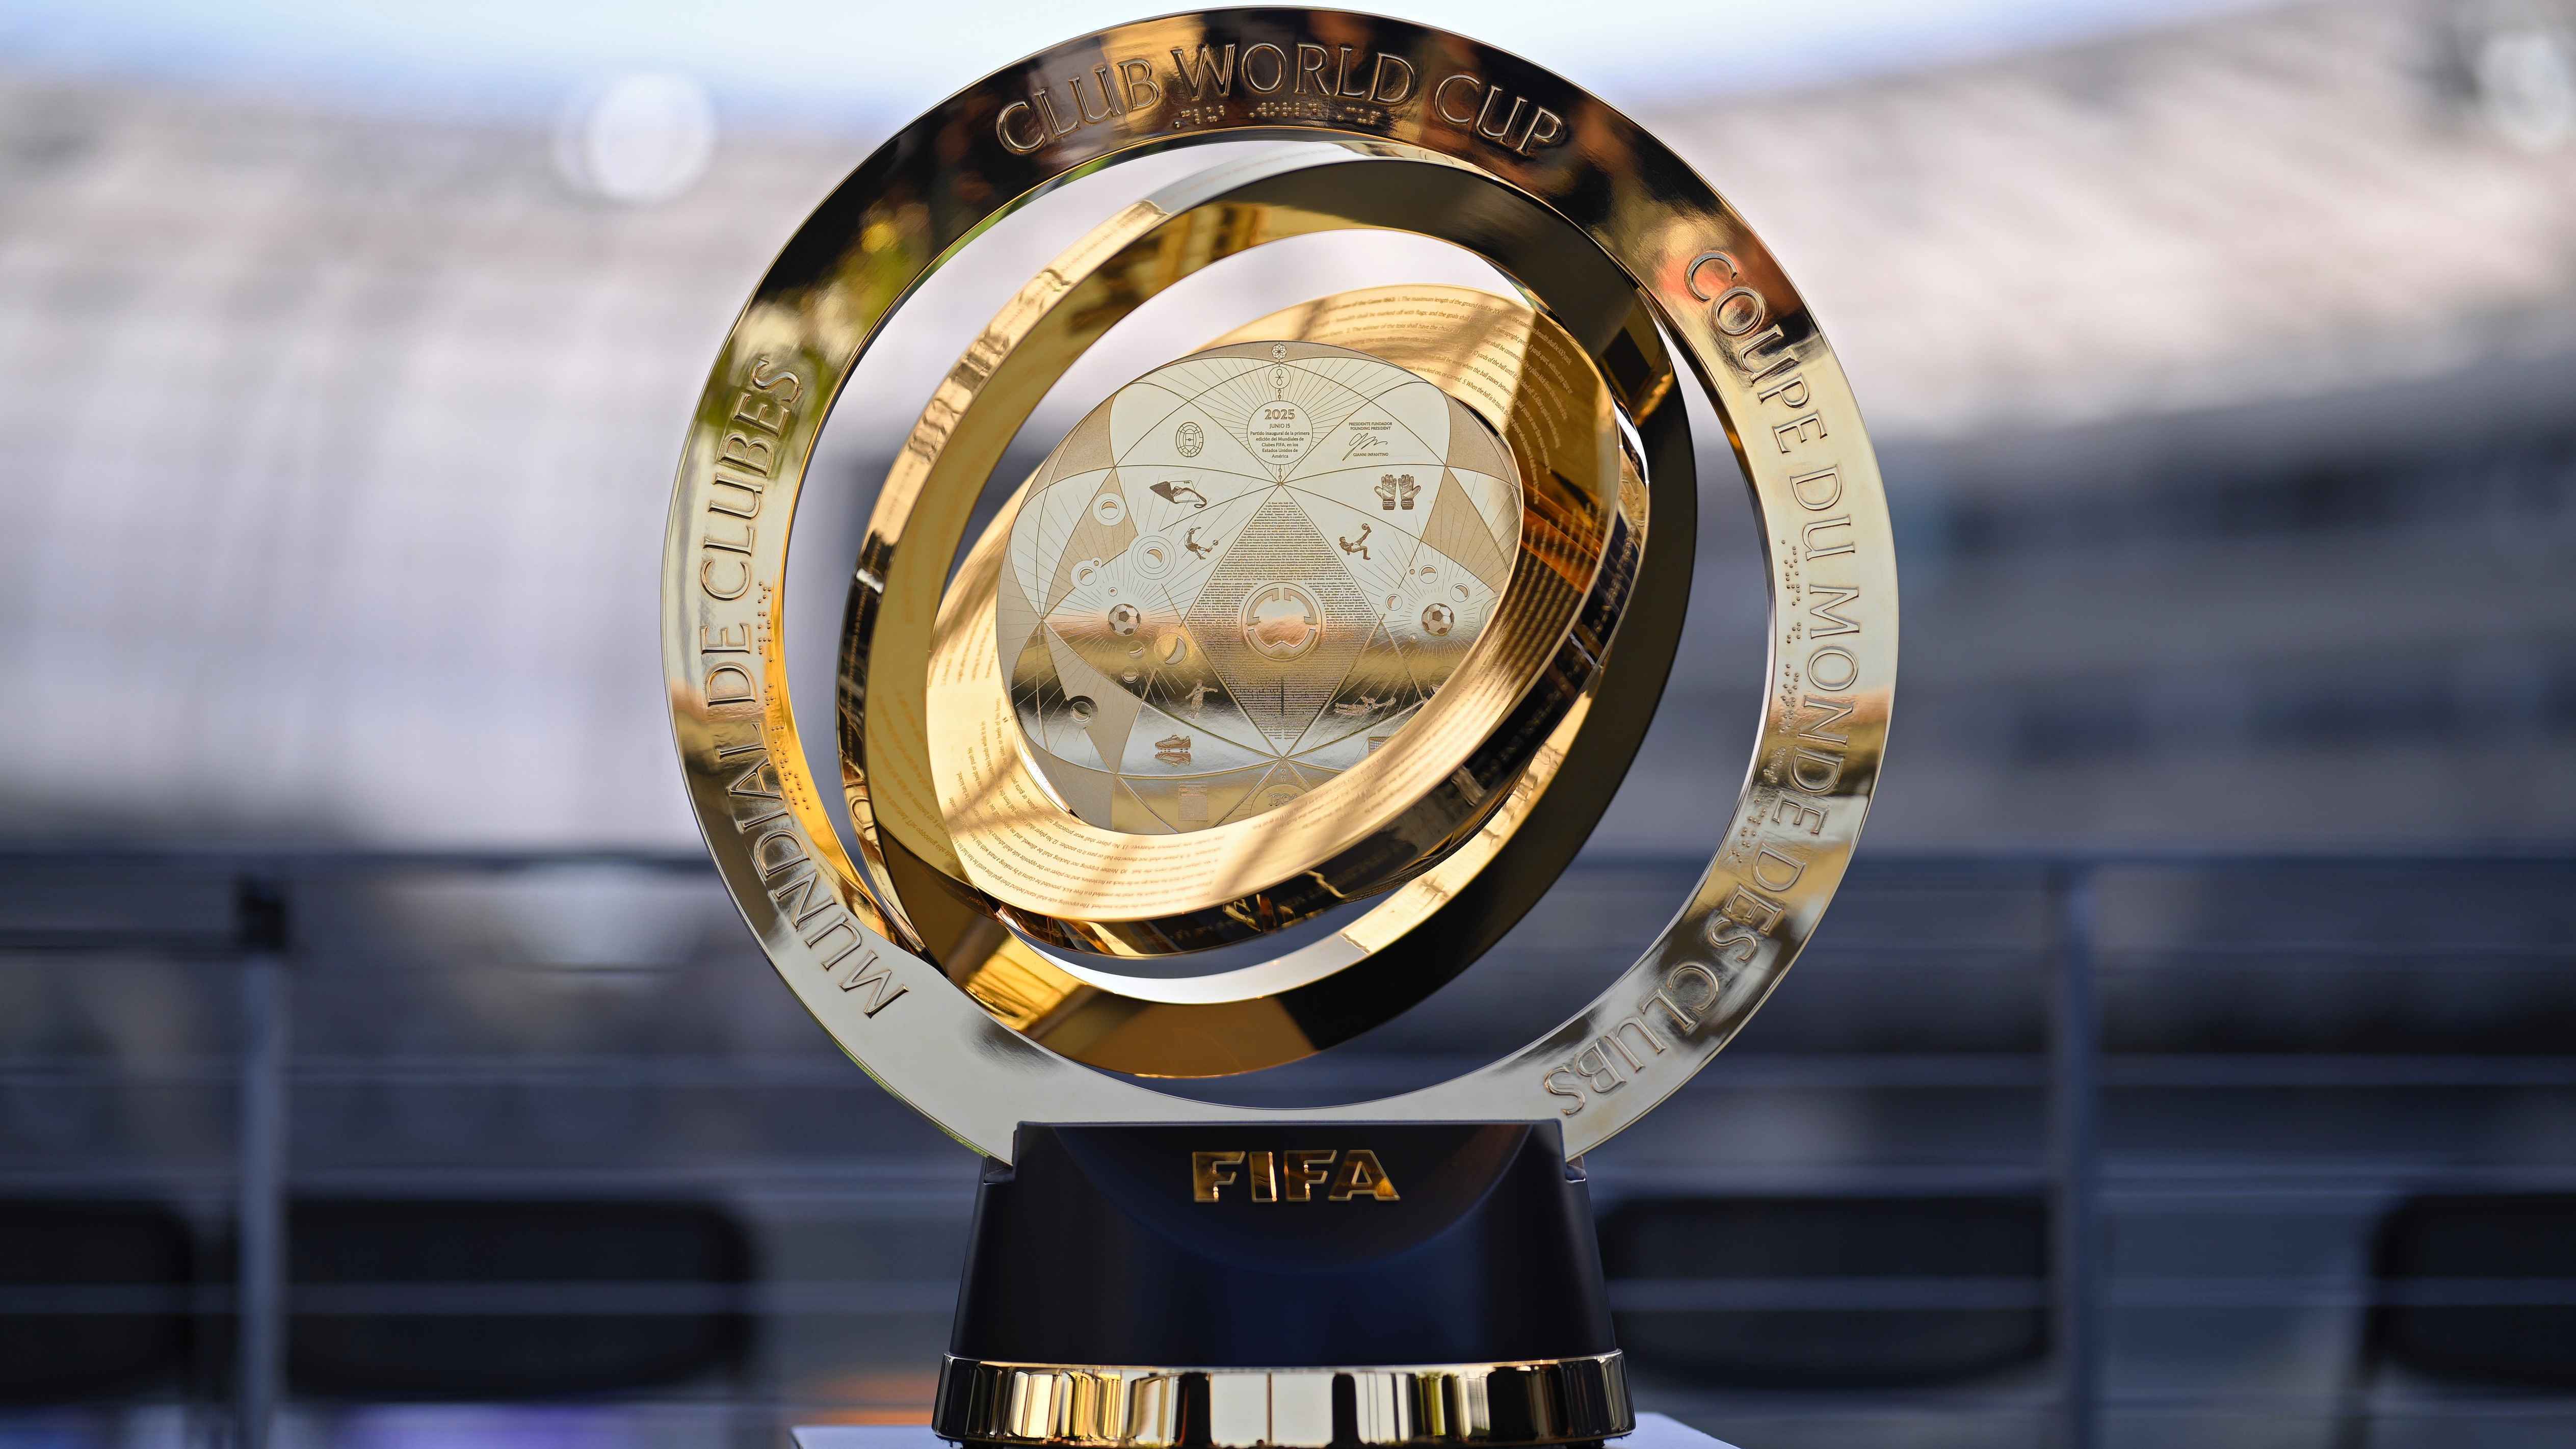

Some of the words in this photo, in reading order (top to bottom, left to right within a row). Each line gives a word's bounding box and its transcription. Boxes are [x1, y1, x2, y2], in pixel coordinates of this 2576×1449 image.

[997, 58, 1160, 155] CLUB
[1171, 41, 1416, 104] WORLD
[1434, 73, 1564, 156] CUP
[1503, 329, 1520, 343] upright
[1490, 339, 1501, 349] shall
[1499, 344, 1506, 352] be
[1685, 250, 1827, 454] COUPE
[1476, 351, 1489, 362] yards
[1487, 355, 1494, 363] of
[1491, 358, 1500, 366] the
[1497, 362, 1507, 371] ball
[1504, 366, 1515, 377] until
[1472, 366, 1481, 375] the
[1479, 370, 1489, 379] ball
[1486, 375, 1500, 387] passes
[1497, 382, 1513, 397] between
[1465, 380, 1479, 391] When
[1476, 386, 1485, 394] the
[1482, 389, 1491, 399] ball
[1265, 409, 1295, 420] 2025
[700, 358, 802, 601] CLUBES
[1790, 464, 1855, 561] DU
[700, 623, 756, 706] DE
[1772, 584, 1859, 835] MONDE
[1001, 794, 1012, 806] from
[1007, 803, 1017, 813] ball
[1024, 821, 1036, 831] shall
[1013, 831, 1023, 841] and
[1033, 826, 1048, 839] player
[1044, 834, 1053, 842] No
[974, 838, 983, 847] his
[990, 832, 1006, 847] advance
[959, 847, 969, 857] had
[979, 844, 989, 854] with
[1002, 843, 1014, 854] shall
[1011, 849, 1021, 858] side
[965, 853, 975, 862] has
[986, 849, 998, 861] mark
[1018, 853, 1038, 867] opposite
[971, 858, 979, 866] he
[975, 861, 987, 873] until
[997, 858, 1014, 872] making
[1035, 862, 1045, 871] the
[716, 720, 909, 1019] MUNDIAL
[983, 867, 994, 877] line
[990, 872, 1003, 882] goal
[999, 877, 1011, 887] their
[1021, 872, 1036, 883] claims
[1707, 841, 1806, 961] DES
[1544, 961, 1720, 1115] CLUBS
[1192, 1149, 1401, 1203] FIFA
